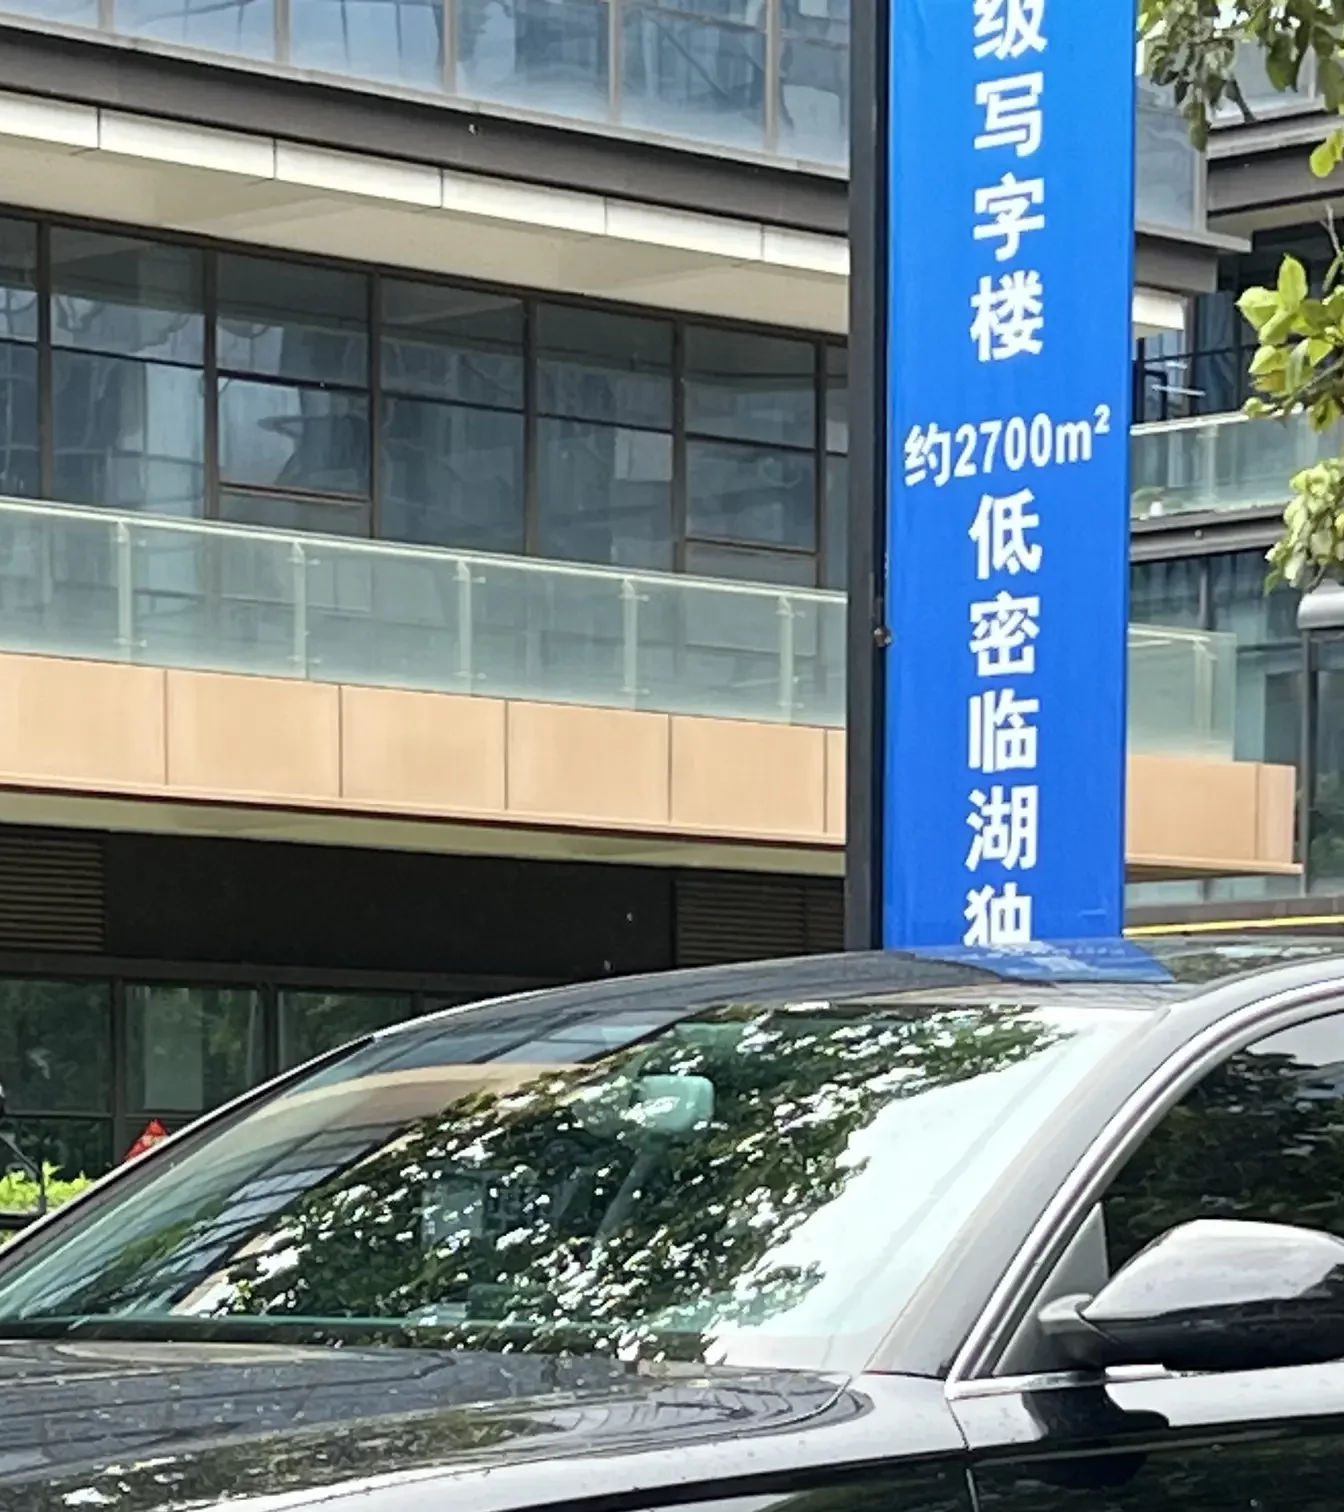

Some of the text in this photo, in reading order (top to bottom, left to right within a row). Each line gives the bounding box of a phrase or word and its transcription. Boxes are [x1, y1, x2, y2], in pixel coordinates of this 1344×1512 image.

[969, 0, 1048, 362] 级写字楼
[903, 404, 1111, 488] 约2700m²
[964, 488, 1043, 947] 低密临湖独
